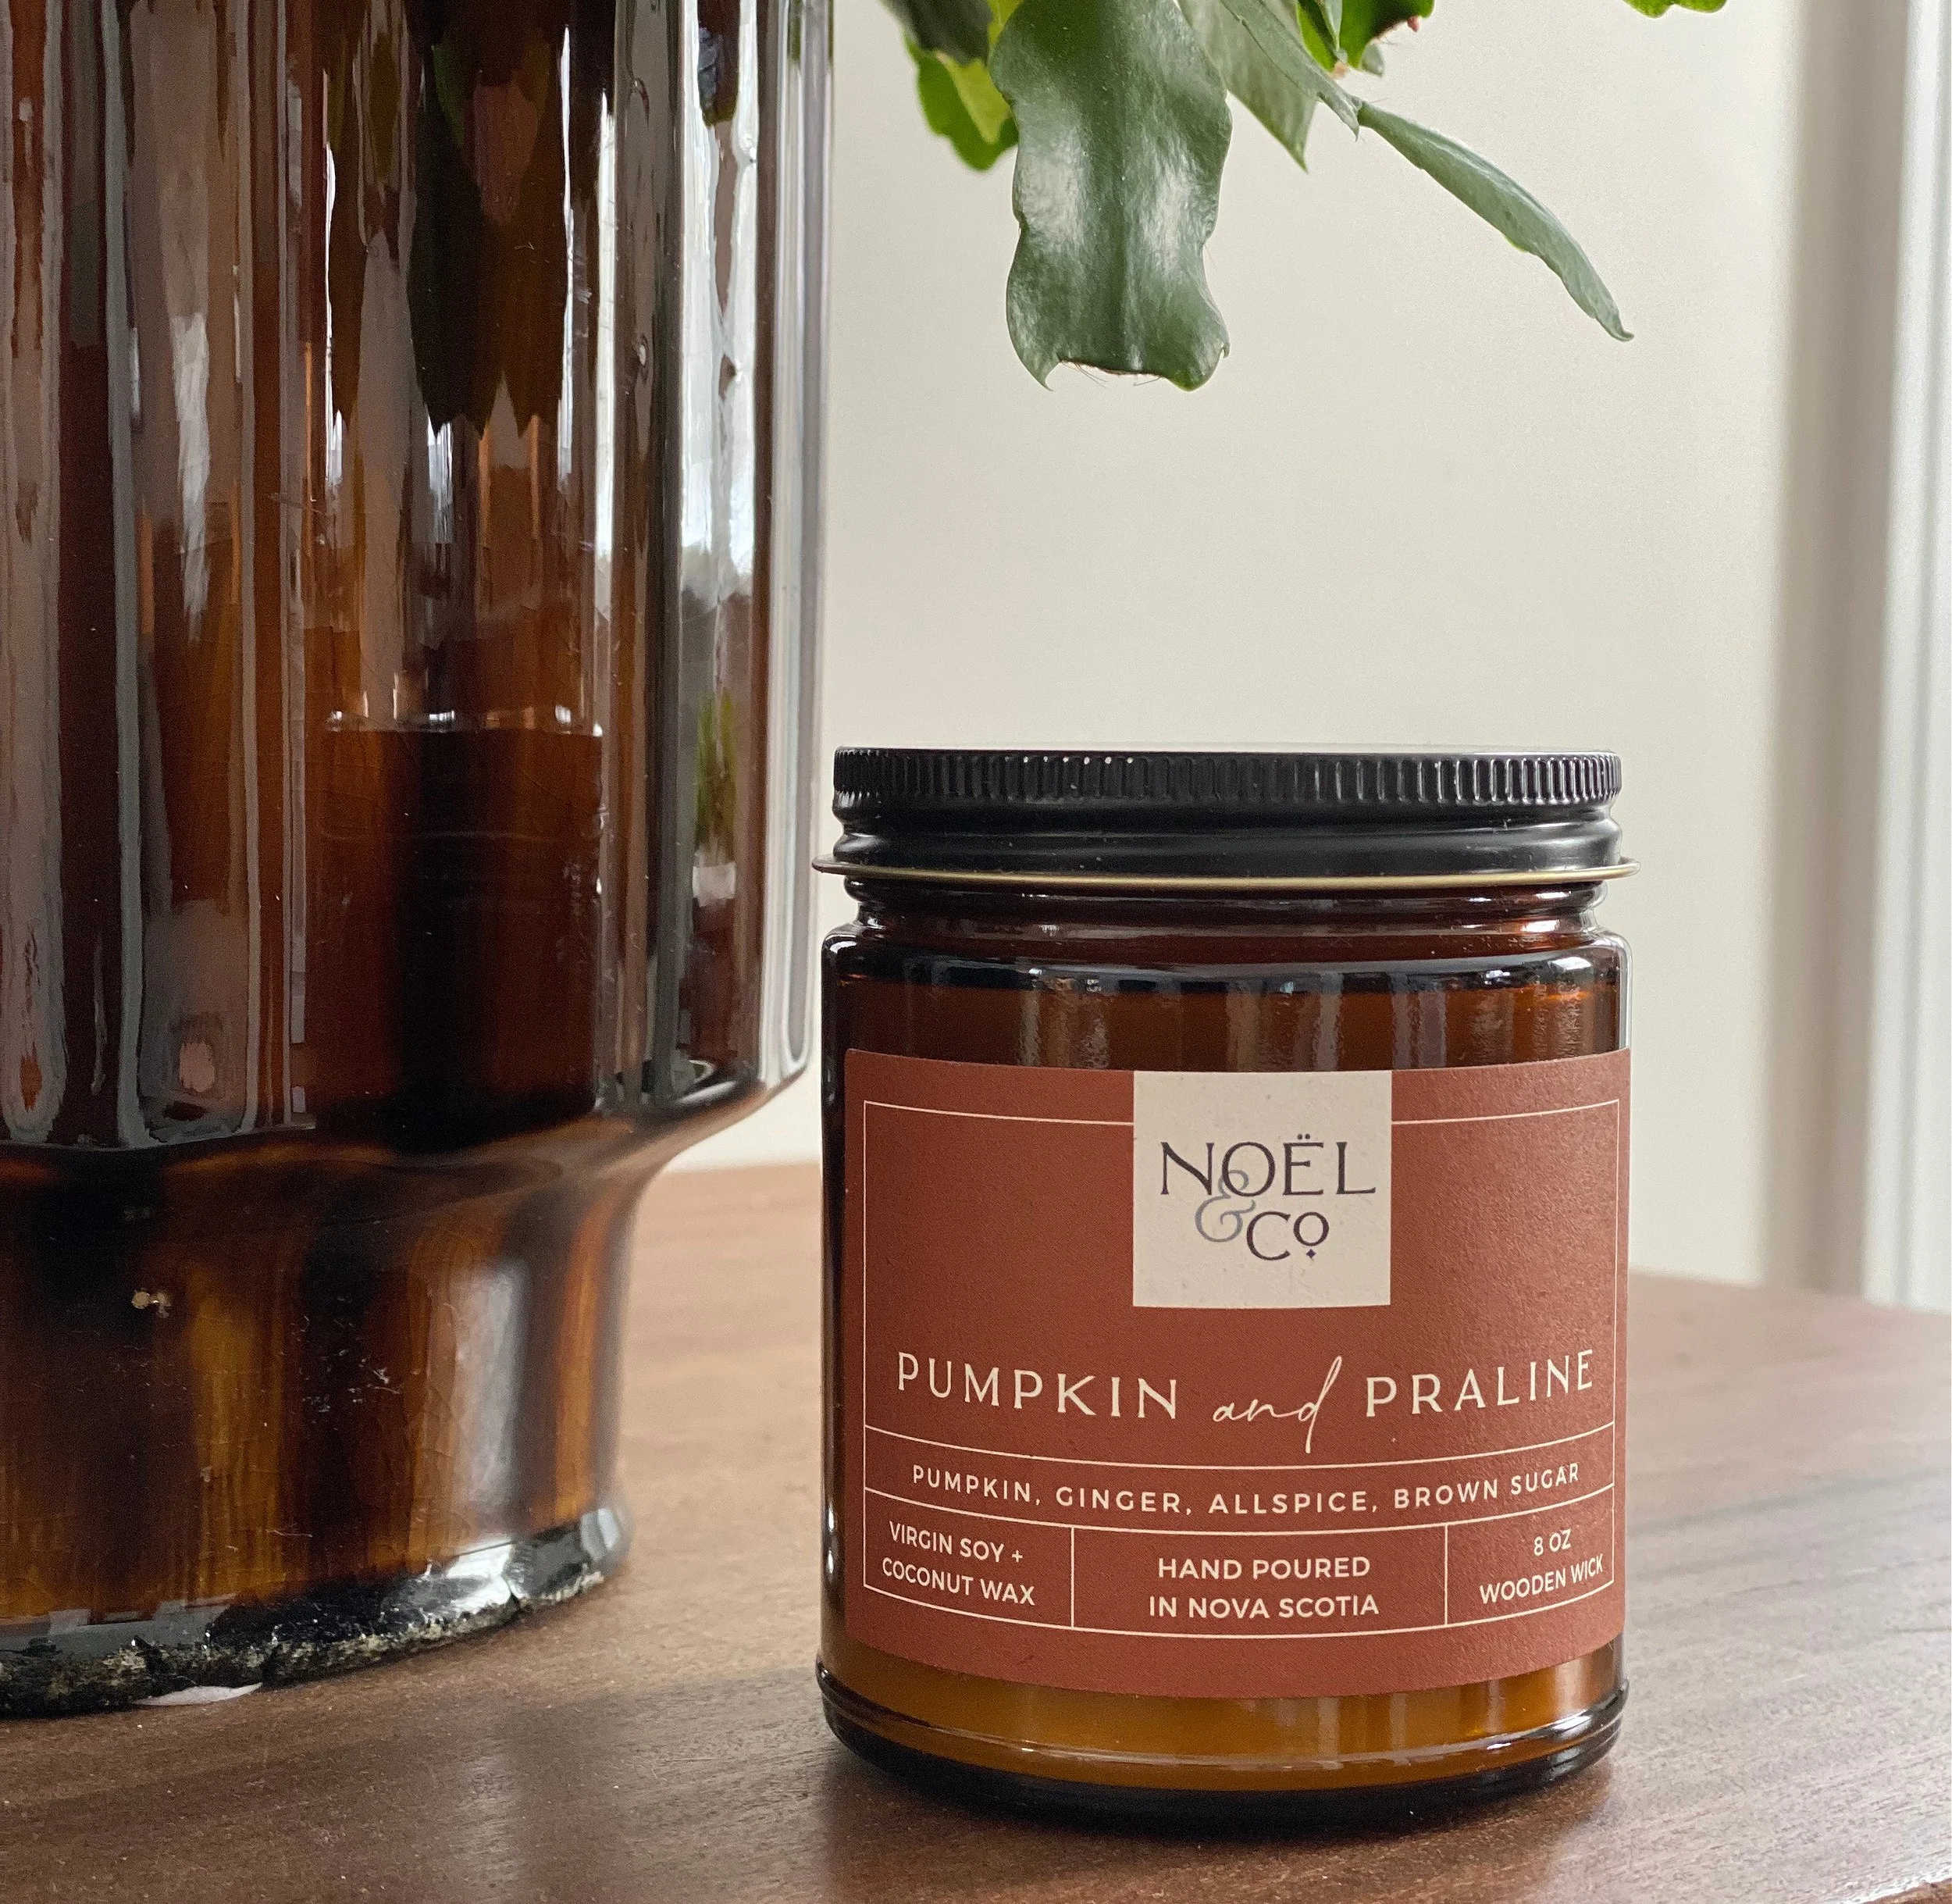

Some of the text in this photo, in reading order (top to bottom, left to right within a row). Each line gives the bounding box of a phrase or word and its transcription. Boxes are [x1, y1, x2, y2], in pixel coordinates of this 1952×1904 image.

[1159, 1132, 1377, 1198] NOËL
[1194, 1168, 1257, 1243] &
[898, 1349, 1593, 1454] PUMPKIN and PRALINE
[912, 1462, 1579, 1516] PUMPKIN, GINGER, ALLSPICE, BROWN SUGAR
[889, 1521, 1024, 1563] VIRGIN SOY +
[1533, 1528, 1572, 1556] 8 OZ
[882, 1556, 1035, 1606] COCONUT WAX
[1158, 1556, 1371, 1580] HAND POURED
[1480, 1554, 1604, 1604] WOODEN WICK
[1149, 1594, 1380, 1619] IN NOVA SCOTIA
